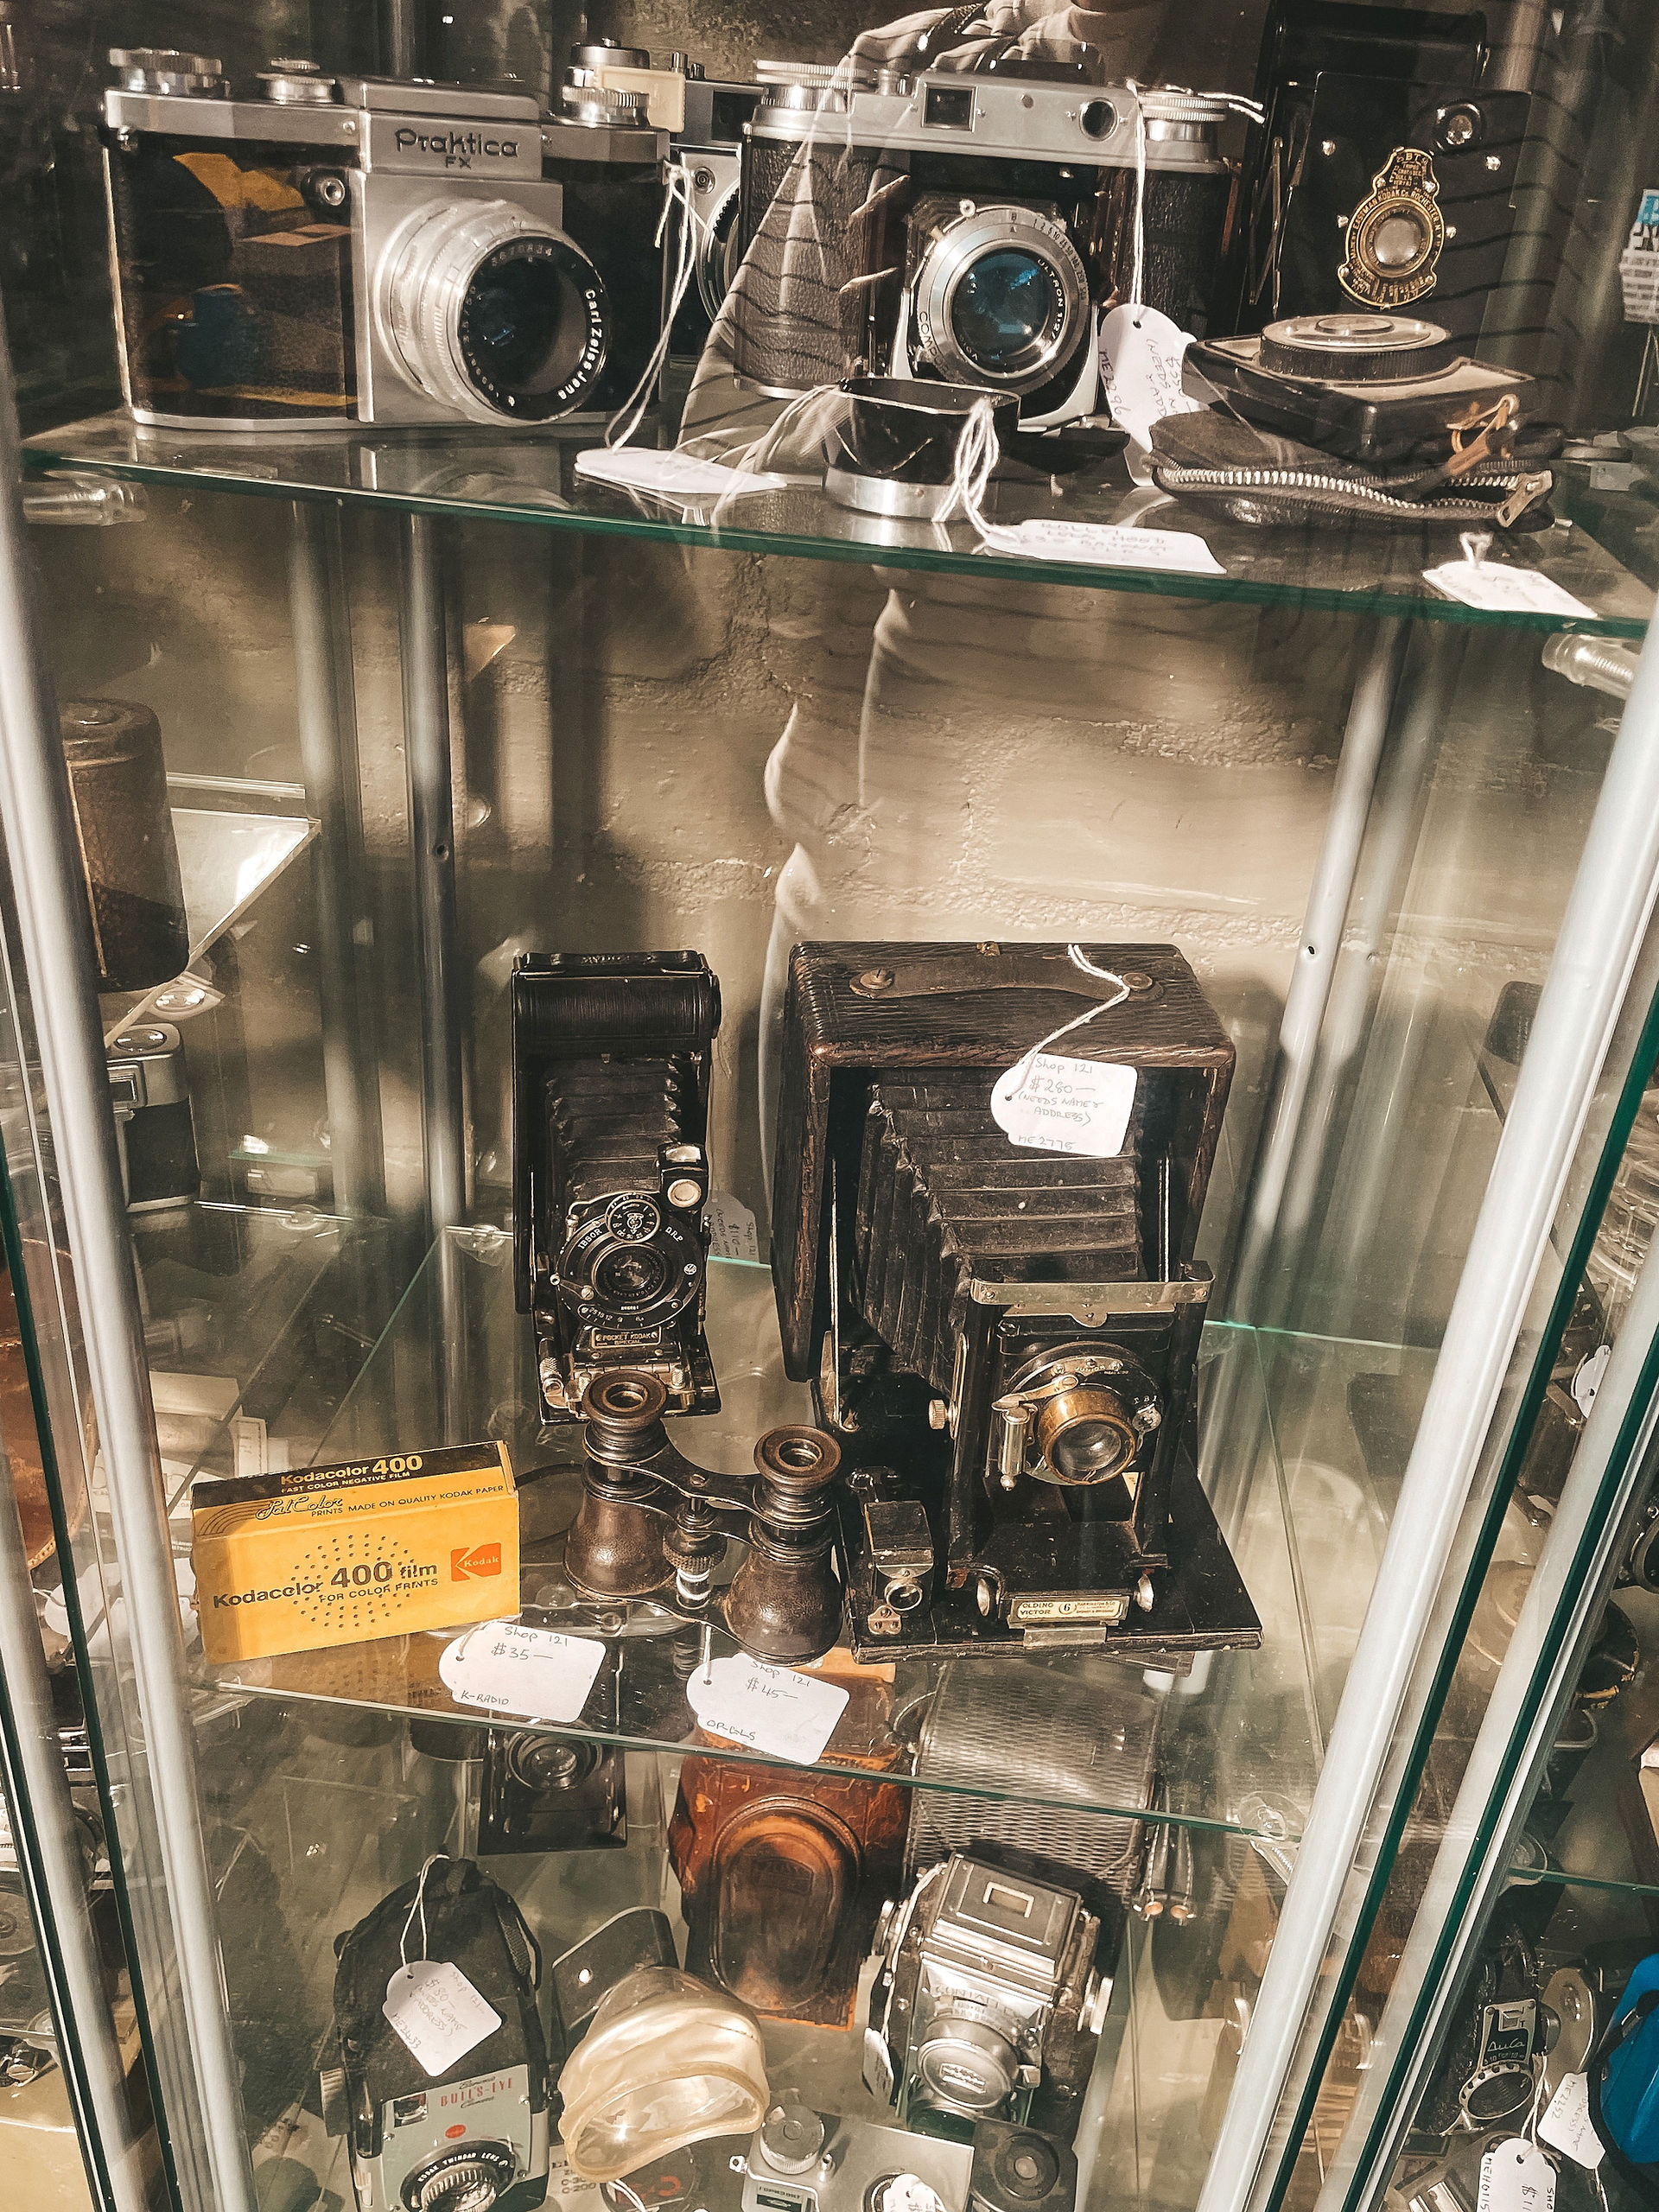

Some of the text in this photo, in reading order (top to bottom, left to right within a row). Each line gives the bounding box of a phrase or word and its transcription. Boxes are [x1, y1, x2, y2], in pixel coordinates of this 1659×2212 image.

[395, 128, 518, 157] Praktica
[445, 156, 472, 170] FX
[1353, 199, 1378, 230] EASTMAN
[1377, 190, 1401, 201] KODAK
[1037, 258, 1064, 307] ULTRON
[558, 289, 603, 400] Carl Zeiss Jena
[1074, 1063, 1093, 1074] 121
[602, 1331, 652, 1341] POCKET KODAK
[280, 1454, 423, 1486] Kodacolor 400
[281, 1470, 411, 1495] FAST COLOR NEGATIVE FILM
[311, 1484, 505, 1518] PRINTS MADE ON QUALITY KODAK PAPER
[463, 1554, 500, 1568] Kodak
[213, 1560, 439, 1609] Kodacolor 400 film
[319, 1578, 440, 1605] FOR COLOR PRINTS
[505, 1626, 569, 1647] Shop 121
[791, 1674, 810, 1688] 121
[461, 1689, 511, 1706] K-RADIO
[417, 2164, 440, 2183] KODAK
[481, 2152, 500, 2162] LENS
